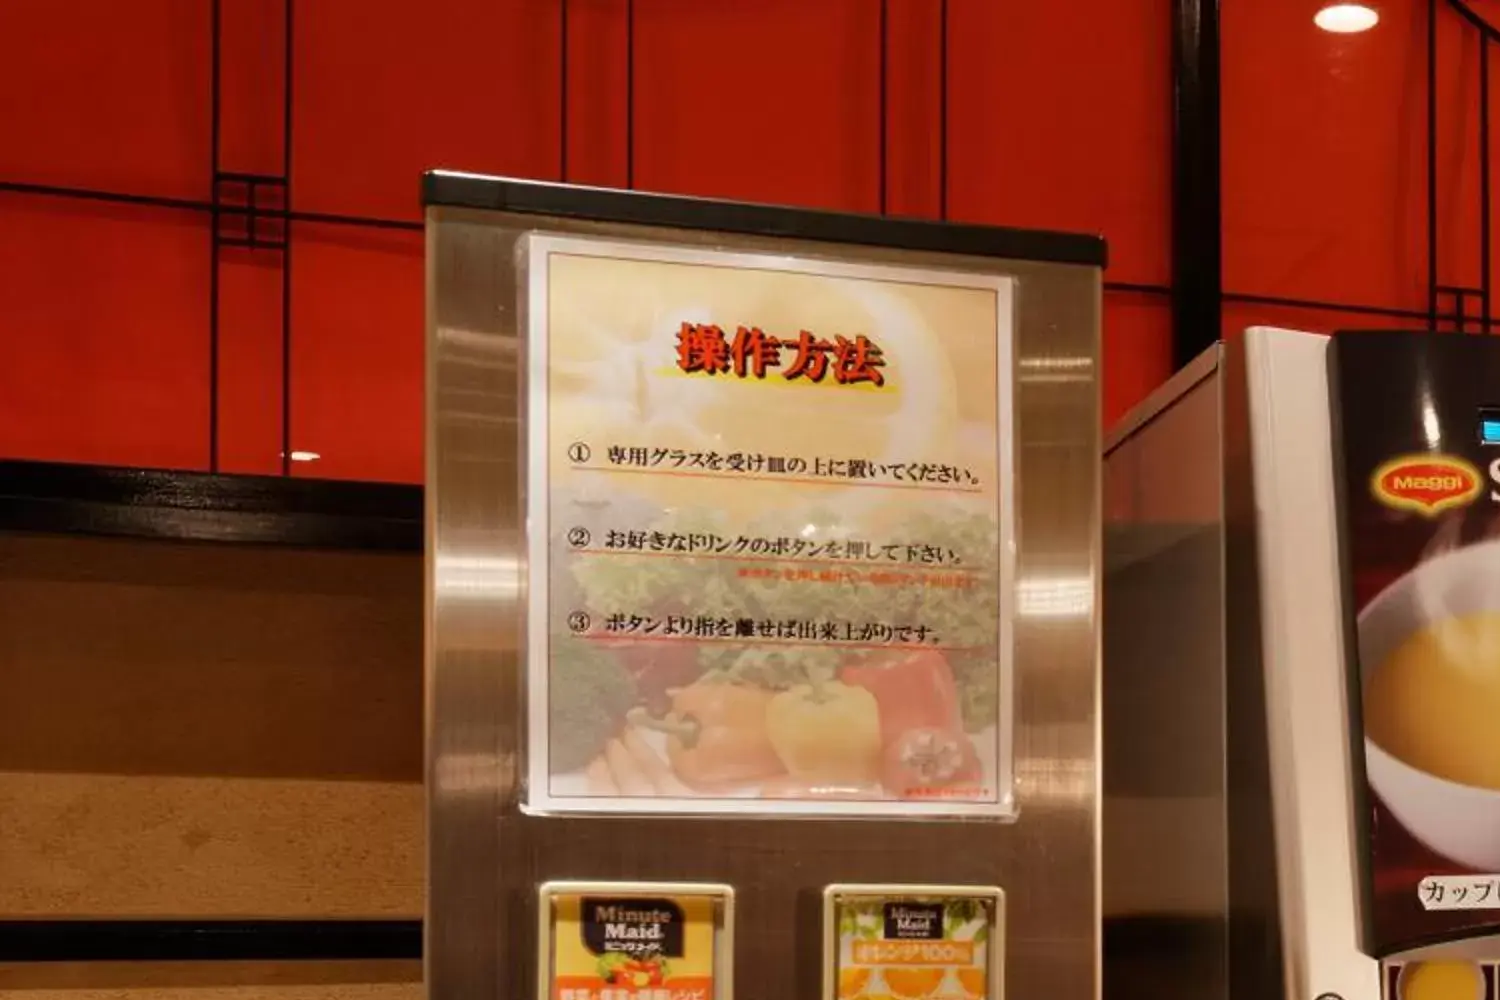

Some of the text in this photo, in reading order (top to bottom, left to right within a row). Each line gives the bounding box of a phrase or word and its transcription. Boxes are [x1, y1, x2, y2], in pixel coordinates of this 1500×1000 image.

[676, 321, 885, 387] 操作方法
[607, 446, 979, 485] 専用グラスを受け皿の上に置いてください。
[1393, 475, 1463, 492] Maggi
[605, 529, 962, 565] お好きなドリンクのボタンを押して下さい。
[595, 905, 672, 923] Minute
[605, 923, 664, 939] Maid
